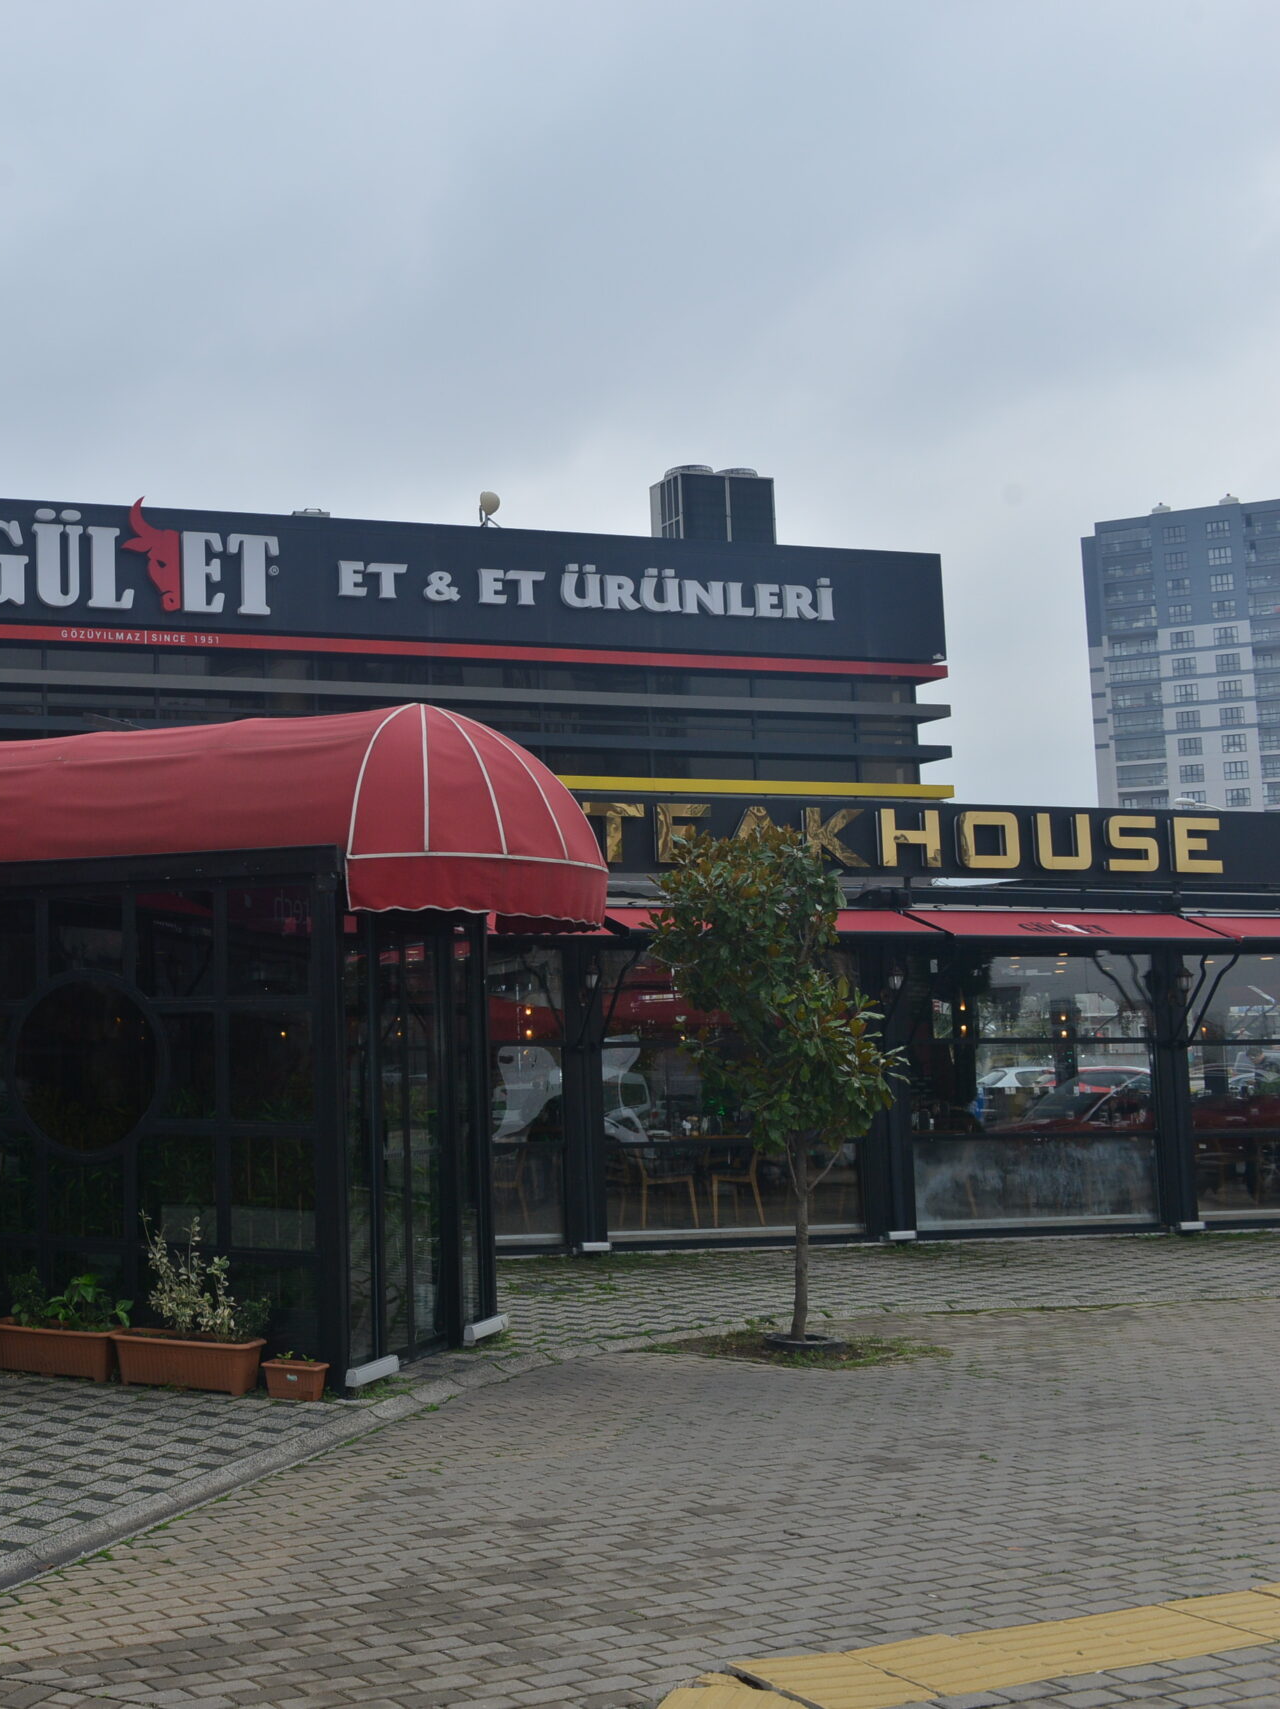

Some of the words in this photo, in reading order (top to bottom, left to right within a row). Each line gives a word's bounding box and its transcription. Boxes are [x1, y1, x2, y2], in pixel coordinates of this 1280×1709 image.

[180, 530, 280, 616] ET
[337, 560, 409, 599] ET
[422, 570, 462, 602] &
[477, 568, 547, 606] ET
[559, 564, 837, 622] ÜRÜNLERİ
[61, 629, 141, 641] GÖZÜYILMAZ
[151, 633, 186, 643] SINCE
[194, 635, 220, 644] 1951
[582, 801, 1224, 874] TEKHOUSE
